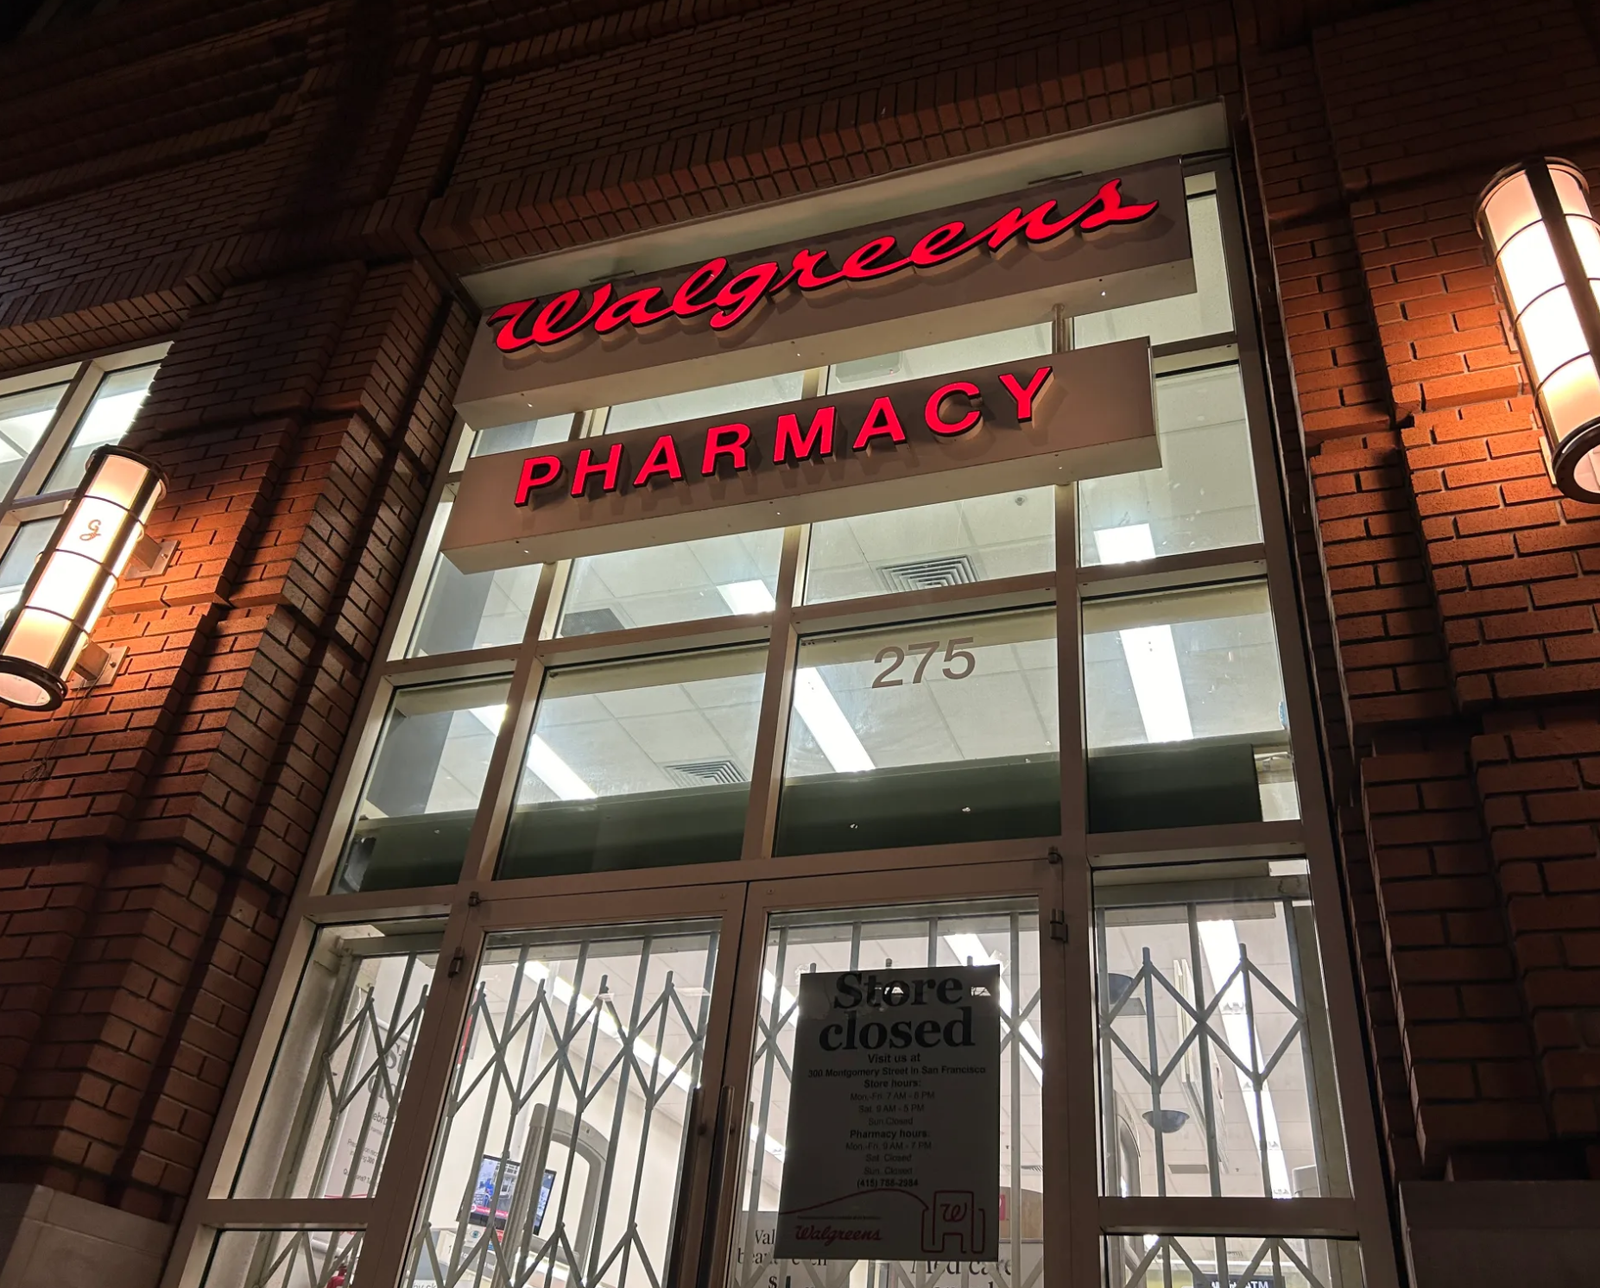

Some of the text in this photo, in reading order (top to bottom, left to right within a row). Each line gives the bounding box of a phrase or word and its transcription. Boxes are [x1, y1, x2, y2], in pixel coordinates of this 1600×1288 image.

[486, 177, 1158, 352] Walgreens
[513, 365, 1055, 506] PHARMACY
[871, 636, 976, 689] 275
[834, 971, 963, 1009] Store
[819, 1006, 976, 1051] closed
[867, 1052, 921, 1064] Visit us at
[808, 1068, 823, 1078] 300
[825, 1067, 879, 1079] Montgomery
[882, 1066, 909, 1076] Street
[921, 1065, 938, 1075] San
[941, 1064, 986, 1075] Francisco
[864, 1078, 921, 1089] Store hours:
[893, 1091, 907, 1100] AM
[921, 1091, 935, 1100] PM
[883, 1104, 896, 1113] AM
[911, 1103, 925, 1112] PM
[849, 1129, 897, 1140] Pharmacy
[889, 1142, 903, 1150] AM
[918, 1141, 932, 1150] PM
[856, 1178, 878, 1189] (415)
[794, 1224, 883, 1247] Walgreens
